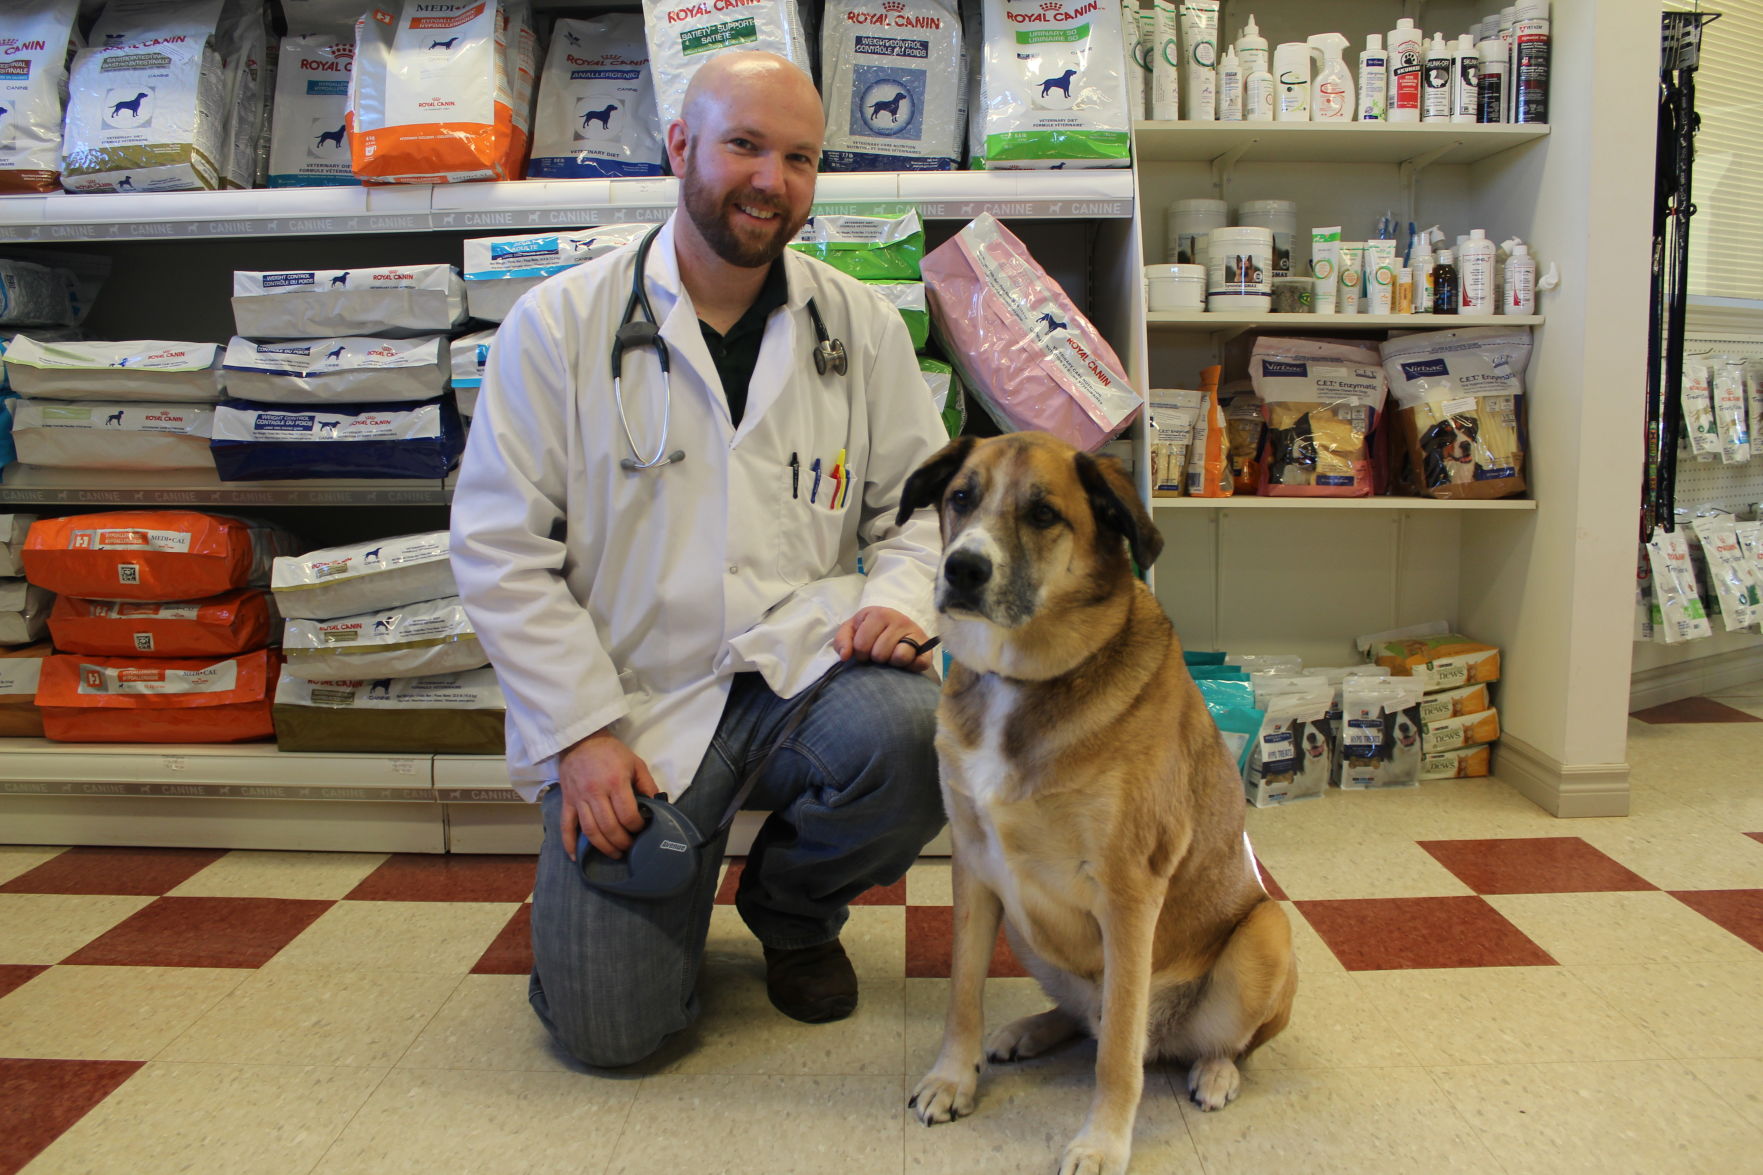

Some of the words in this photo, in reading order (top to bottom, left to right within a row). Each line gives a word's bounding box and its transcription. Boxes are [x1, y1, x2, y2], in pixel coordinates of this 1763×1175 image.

[667, 2, 711, 23] ROYAL
[1007, 11, 1050, 23] ROYAL
[1053, 0, 1098, 21] CANIN
[847, 11, 891, 25] ROYAL
[895, 15, 940, 30] CANIN
[4, 40, 46, 56] CANIN
[862, 38, 891, 46] WEIGHT
[892, 40, 922, 49] CONTROL
[300, 58, 341, 72] ROYAL
[566, 54, 606, 66] ROYAL
[572, 71, 639, 79] ANALLERGENIC
[51, 226, 96, 237] CANINE
[130, 223, 173, 235] CANINE
[209, 221, 253, 233] CANINE
[288, 218, 334, 231] CANINE
[370, 216, 414, 228] CANINE
[464, 212, 512, 225] CANINE
[551, 210, 598, 223] CANINE
[983, 203, 1032, 216] CANINE
[1072, 202, 1121, 215] CANINE
[1067, 338, 1089, 362] ROYAL
[1087, 360, 1112, 387] CANIN
[1339, 381, 1377, 391] Enzymatic
[79, 491, 121, 501] CANINE
[155, 491, 198, 501] CANINE
[1439, 670, 1465, 681] news
[1424, 705, 1450, 717] news
[1435, 732, 1462, 743] news
[1430, 761, 1456, 771] news
[161, 785, 206, 795] CANINE
[241, 786, 285, 797] CANINE
[321, 788, 366, 798] CANINE
[471, 790, 521, 800] CANINE
